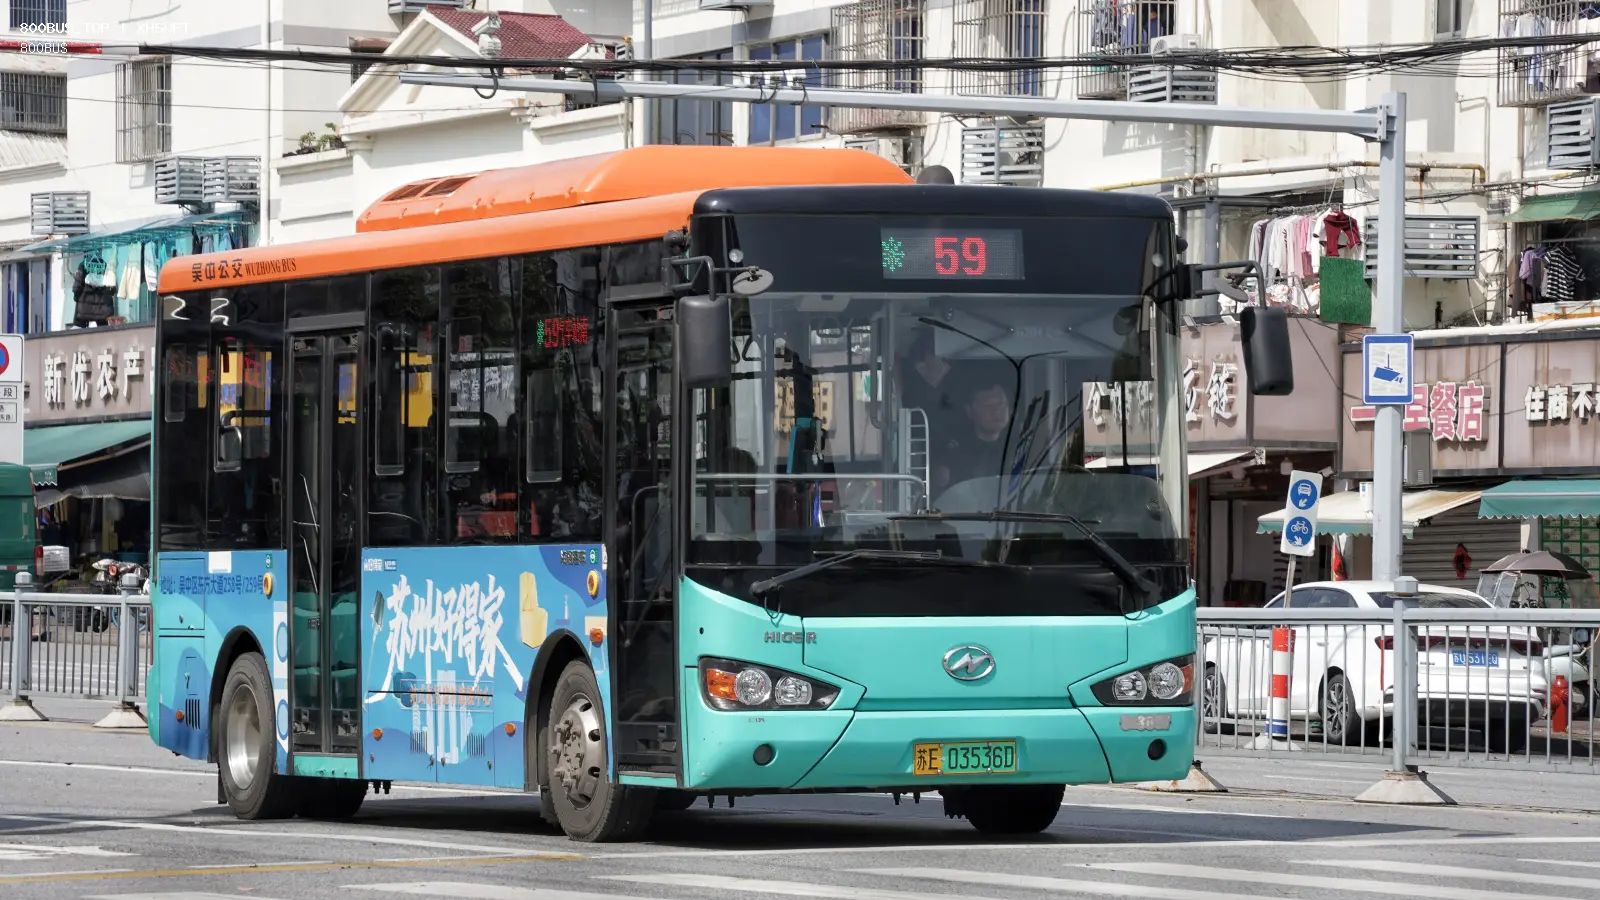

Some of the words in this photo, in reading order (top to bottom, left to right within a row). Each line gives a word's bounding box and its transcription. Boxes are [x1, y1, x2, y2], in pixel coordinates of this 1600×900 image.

[191, 258, 243, 283] 吴中公交
[245, 259, 280, 277] WUZHONG
[281, 257, 297, 273] BUS
[934, 236, 987, 275] 59
[44, 346, 154, 404] 新优农产
[1524, 382, 1600, 422] 住商不
[364, 573, 524, 704] 苏州好得家
[764, 631, 818, 643] HIGER
